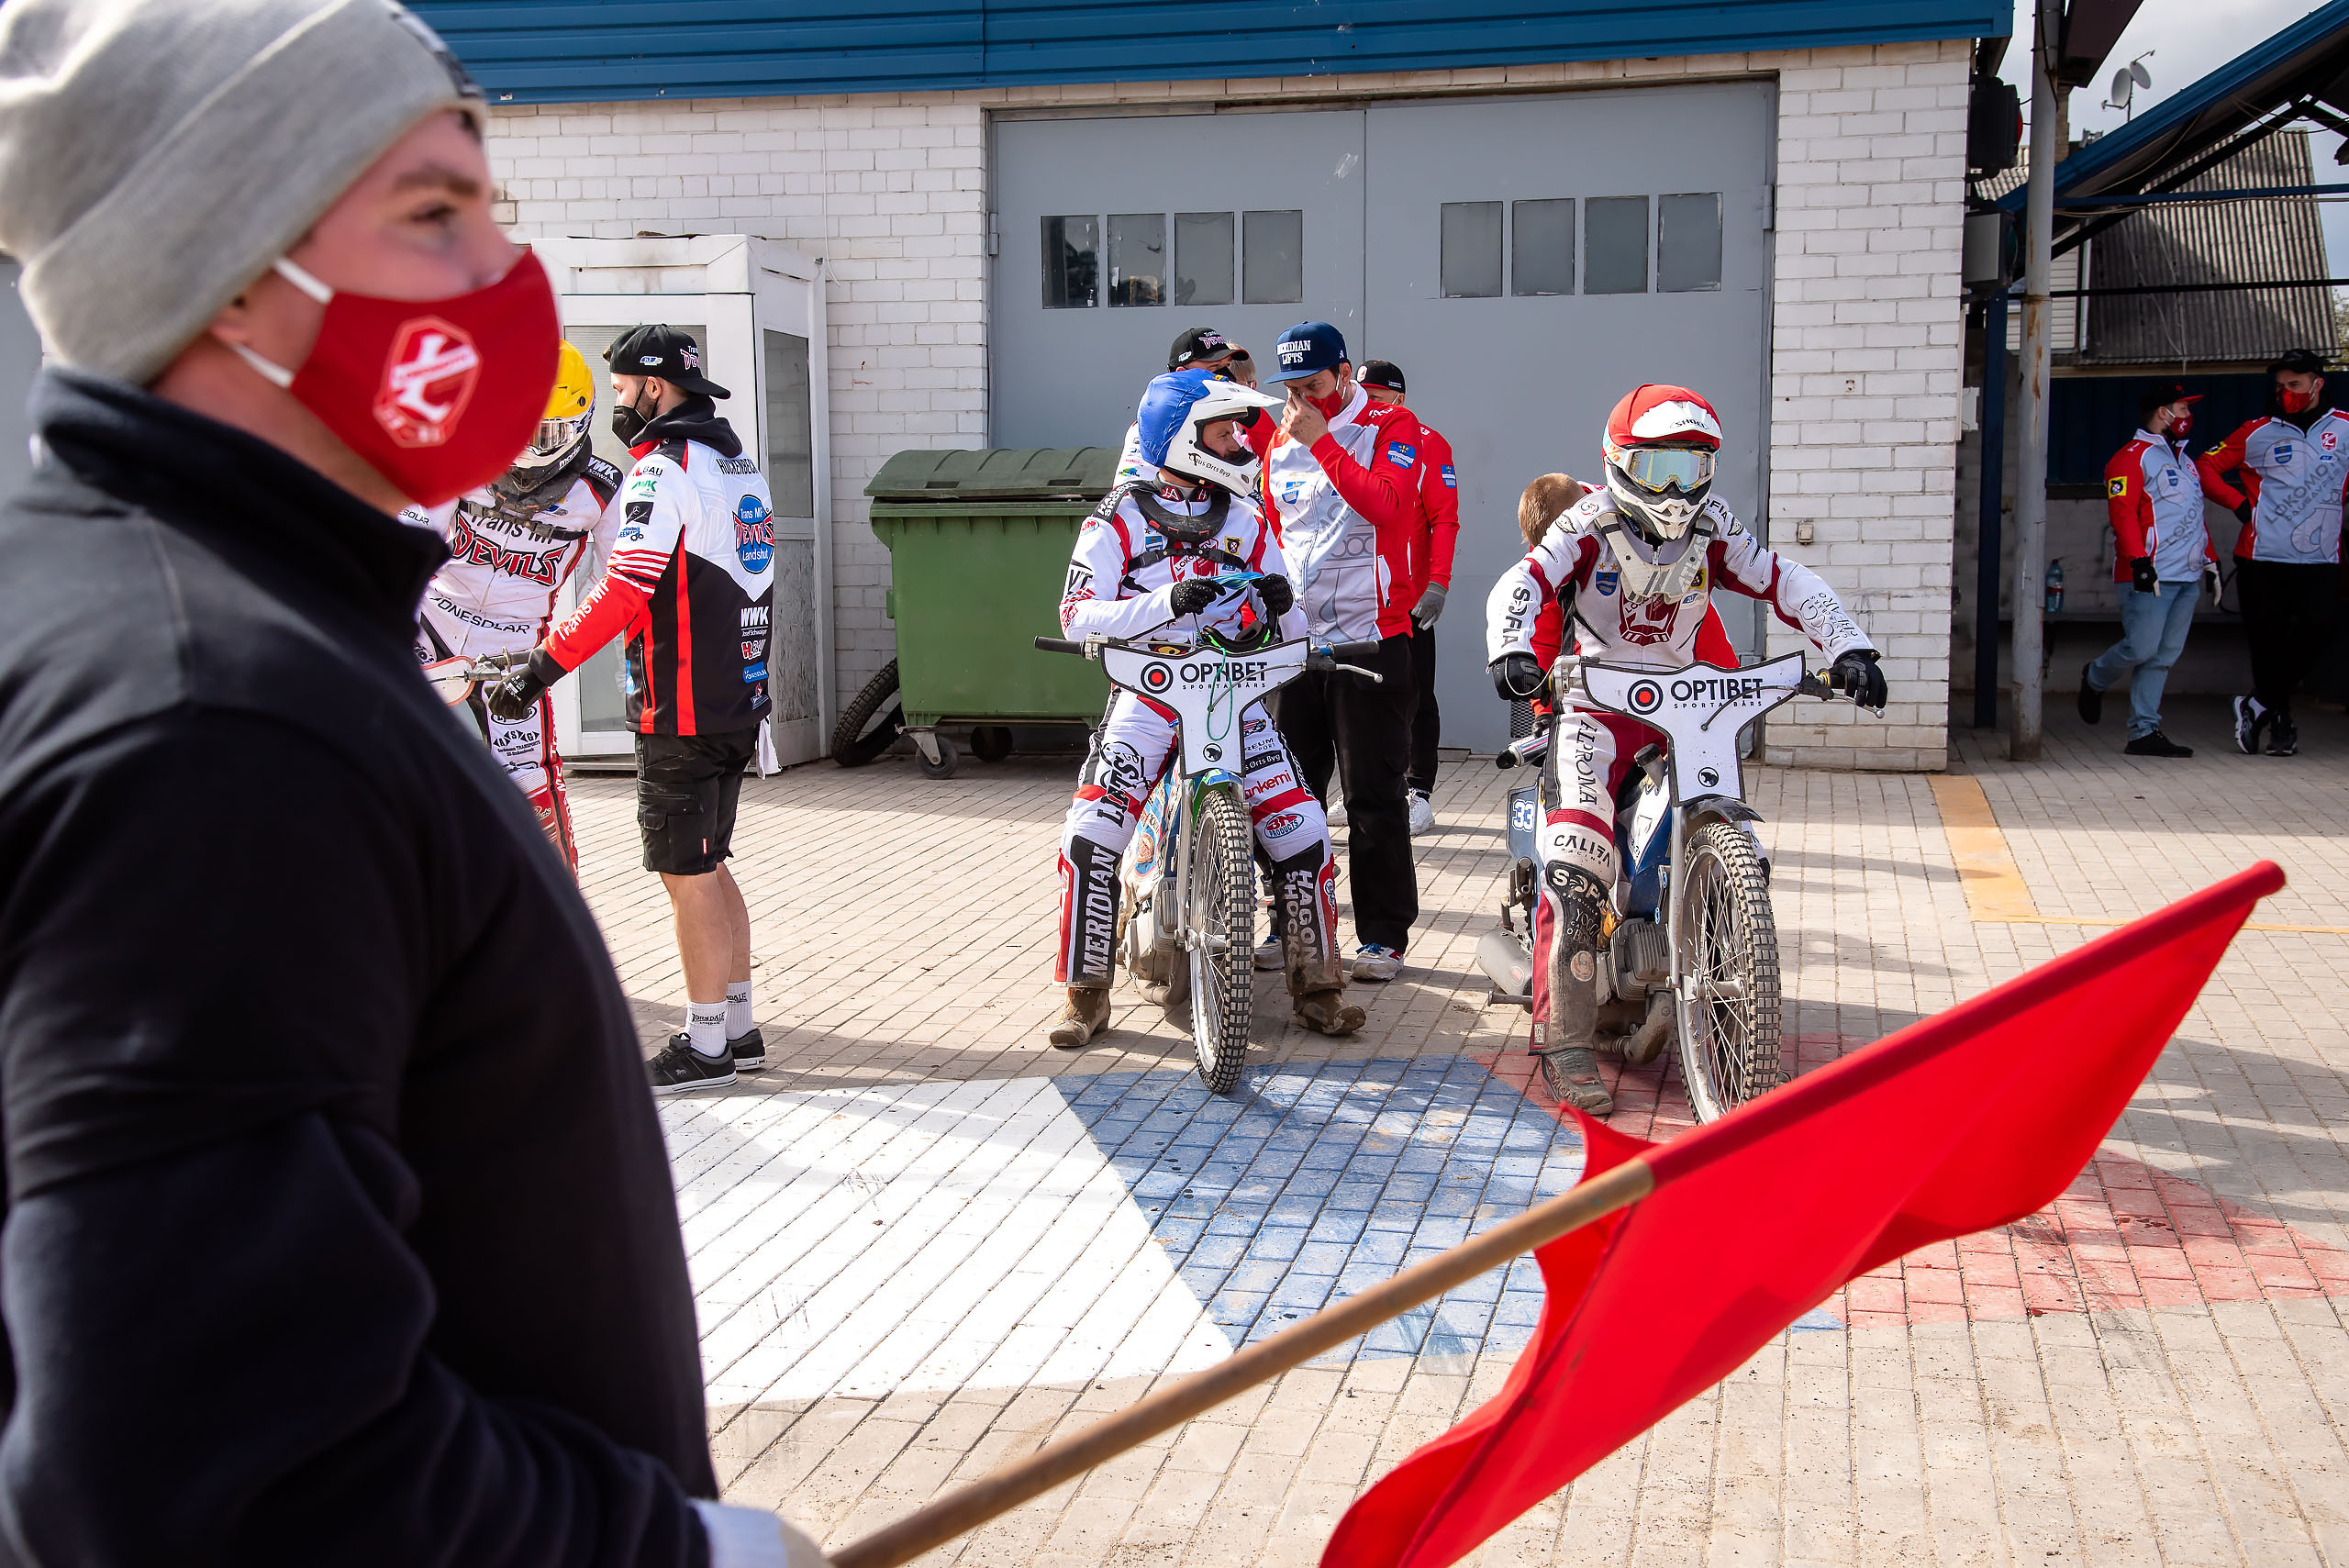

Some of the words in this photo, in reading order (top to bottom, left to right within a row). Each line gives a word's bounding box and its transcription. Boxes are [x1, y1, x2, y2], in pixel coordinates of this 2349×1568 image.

[740, 507, 752, 518] Trans
[731, 509, 774, 552] DEVILS
[451, 507, 571, 587] DEVILS
[742, 548, 769, 562] Landshut
[1678, 535, 1707, 594] ATLAS
[556, 602, 592, 640] Trans
[740, 606, 770, 628] WWK
[1180, 662, 1267, 684] OPTIBET
[1671, 678, 1764, 702] OPTIBET
[1249, 758, 1266, 769] Ørts
[1266, 753, 1281, 763] Byg
[1244, 769, 1293, 800] ankemi
[1268, 819, 1299, 837] PRODUCTS
[1512, 799, 1536, 833] 33
[1083, 845, 1118, 979] MERIDIAN
[1297, 869, 1318, 964] HAGON
[726, 992, 747, 1003] DALE
